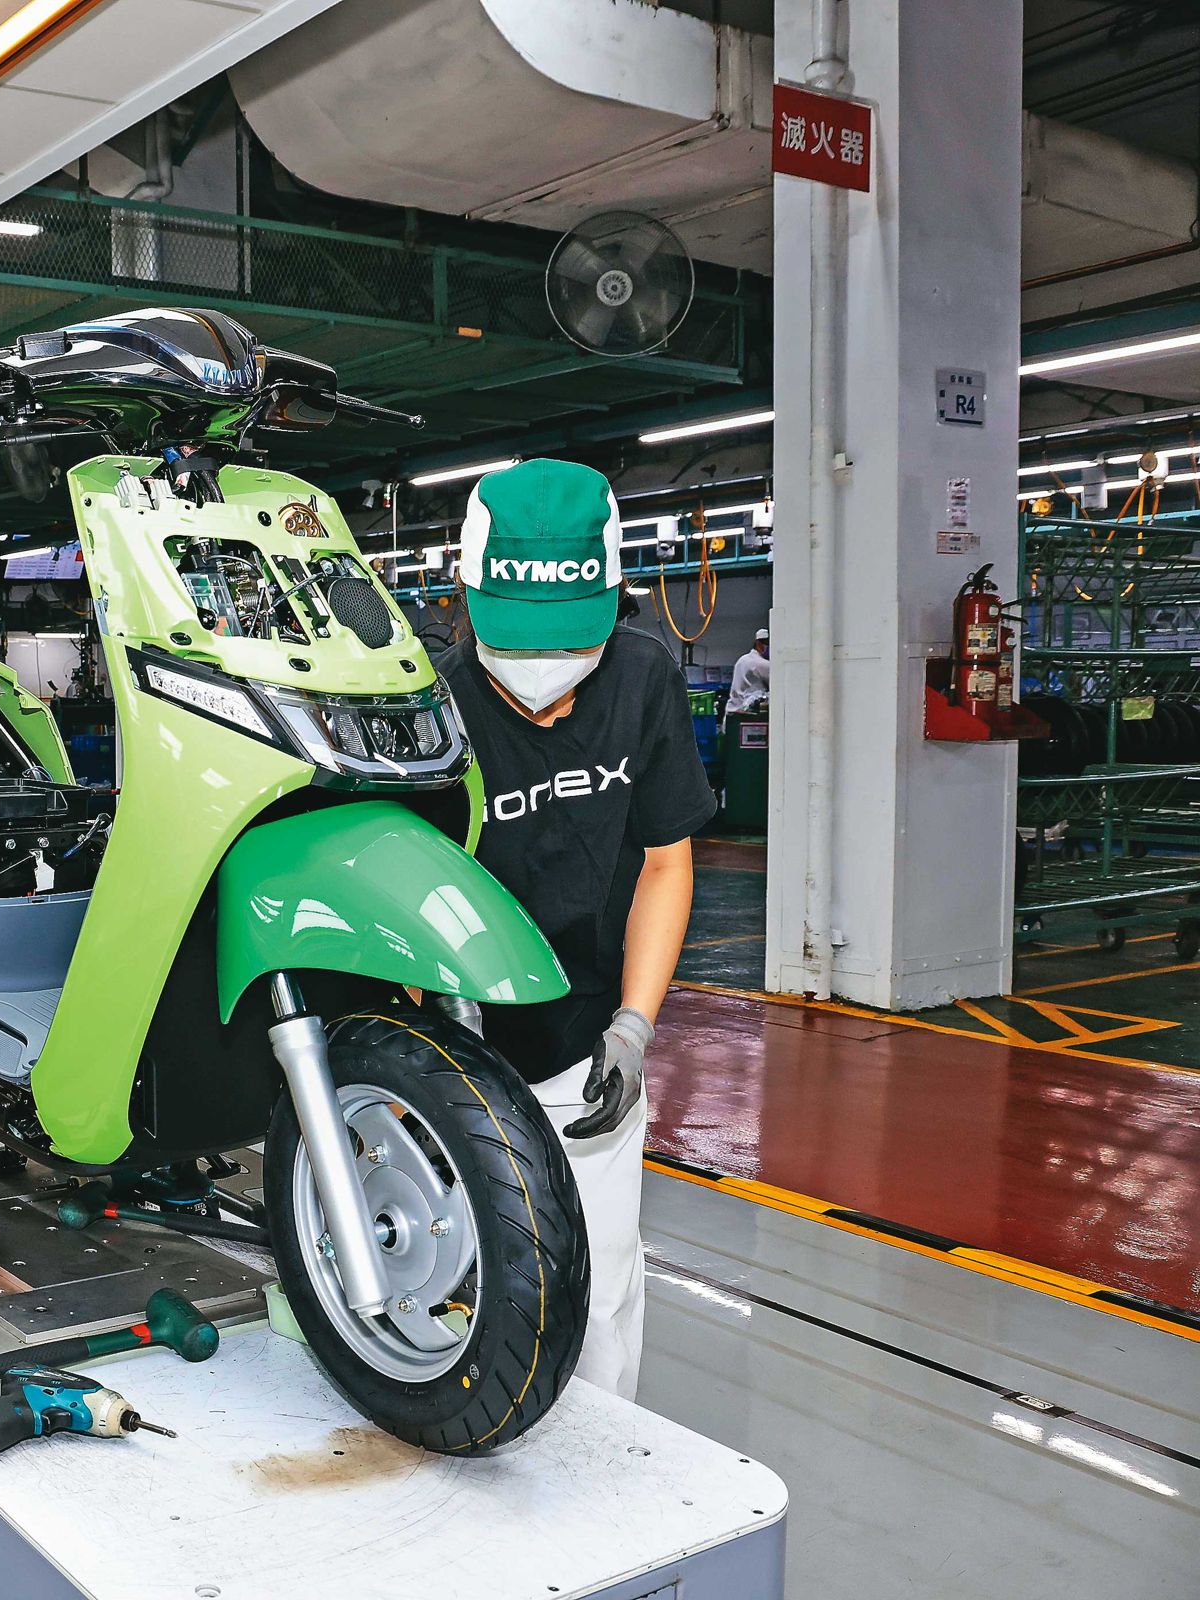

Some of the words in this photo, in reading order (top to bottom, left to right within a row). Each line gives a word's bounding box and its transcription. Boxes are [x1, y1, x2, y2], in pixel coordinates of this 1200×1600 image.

[780, 111, 864, 165] 滅火器
[956, 394, 976, 415] R4
[490, 558, 600, 583] KYMCO
